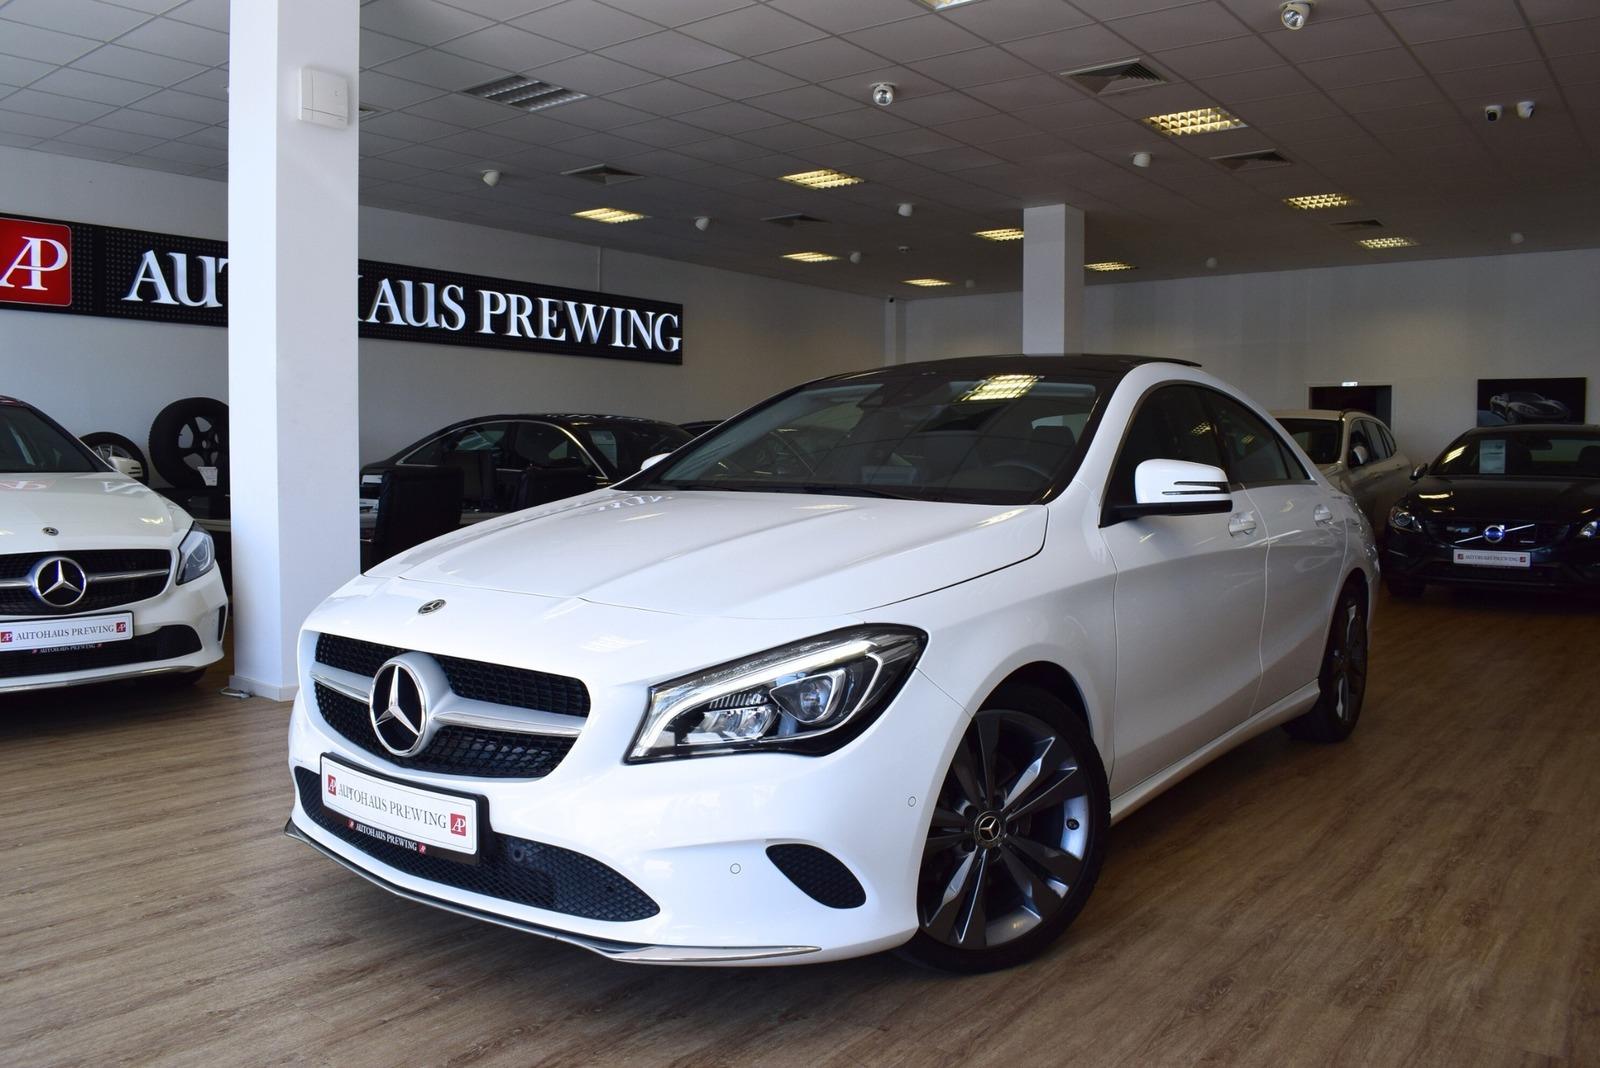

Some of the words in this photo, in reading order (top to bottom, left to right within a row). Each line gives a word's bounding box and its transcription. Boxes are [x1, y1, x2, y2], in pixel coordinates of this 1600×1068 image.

[475, 289, 682, 352] PREWING
[16, 631, 70, 641] AUTOHAUS
[71, 624, 115, 636] PREWING
[338, 783, 387, 813] AUTOHAUS
[390, 800, 448, 829] PREWING
[355, 823, 387, 841] AUTOHAUS
[386, 834, 418, 852] PREWING
